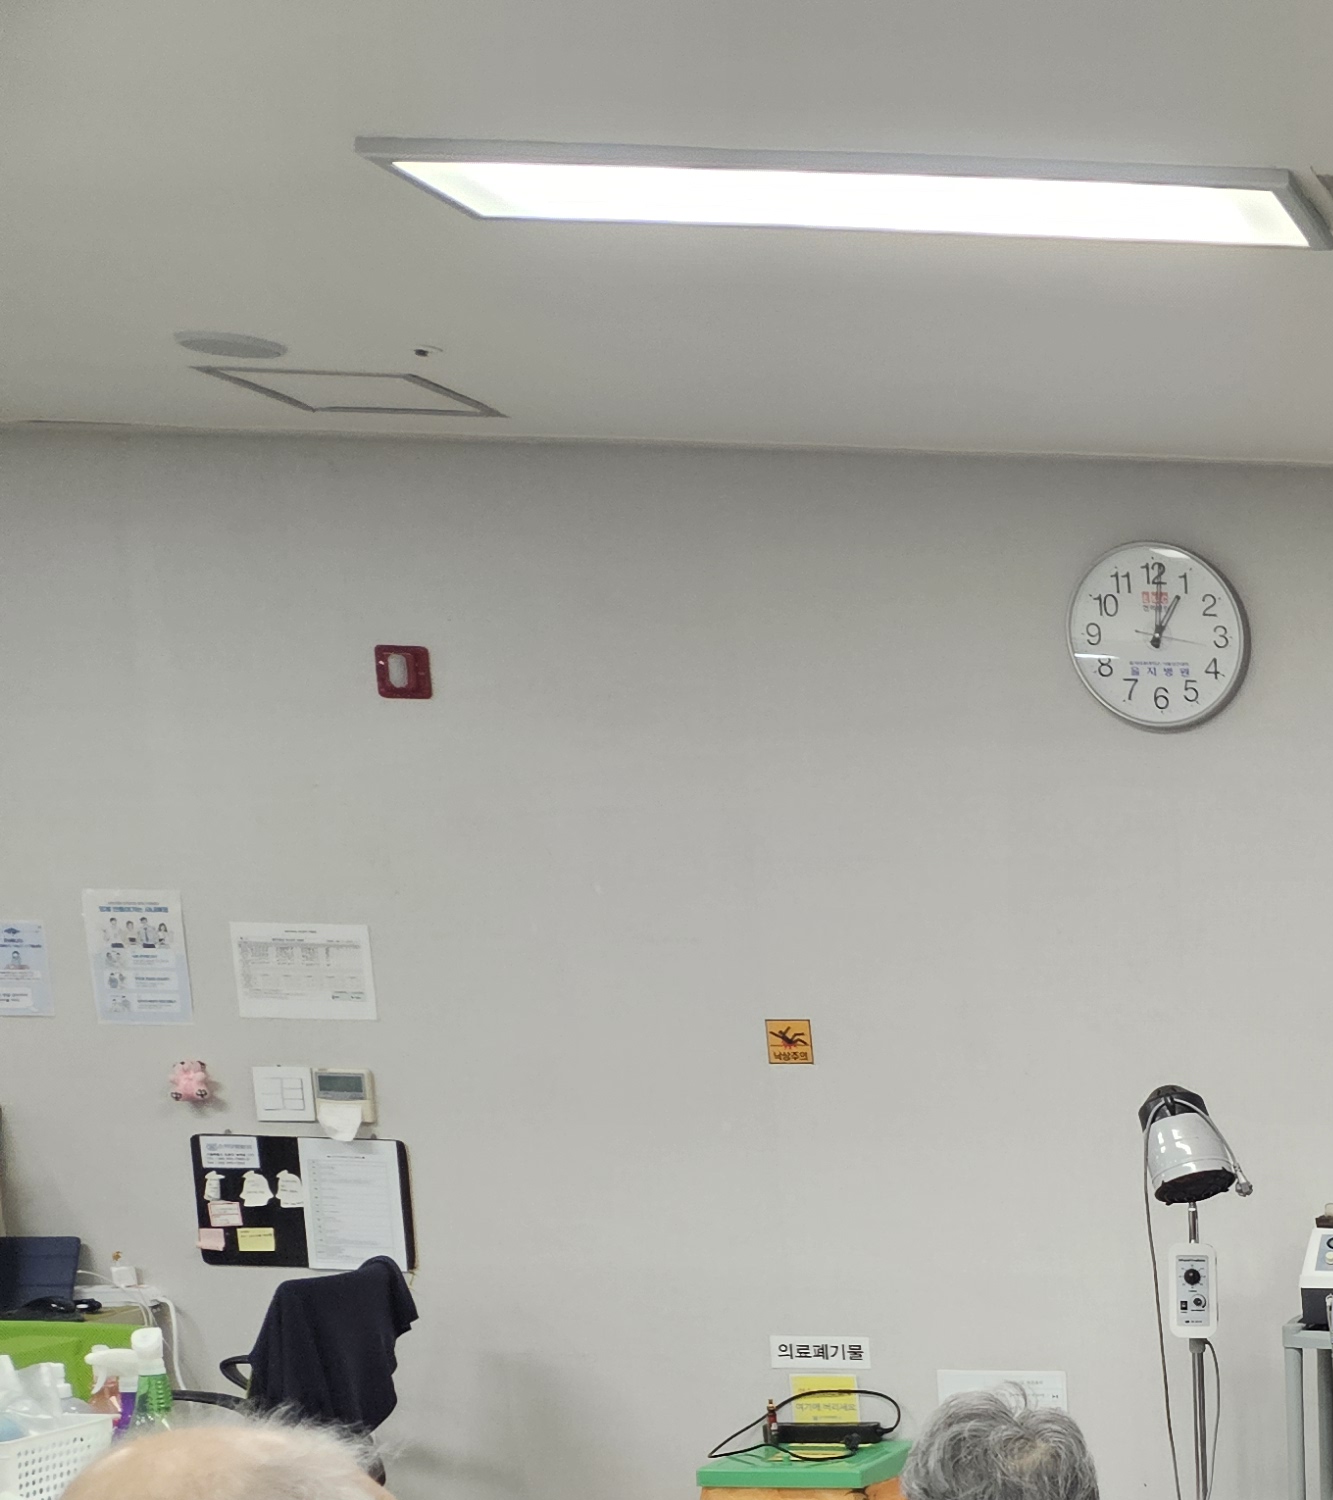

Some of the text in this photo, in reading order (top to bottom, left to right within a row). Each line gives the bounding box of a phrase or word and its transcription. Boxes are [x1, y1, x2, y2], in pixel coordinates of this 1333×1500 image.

[1110, 571, 1132, 594] 11
[1141, 562, 1167, 585] 12
[1179, 573, 1188, 594] 1
[1094, 594, 1118, 617] 10
[1202, 594, 1217, 617] 2
[1086, 622, 1102, 645] 9
[1214, 625, 1229, 649] 3
[1098, 655, 1113, 677] 8
[1205, 658, 1220, 680] 4
[1123, 678, 1138, 700] 7
[1154, 687, 1169, 709] 6
[1184, 680, 1199, 702] 5
[773, 1051, 808, 1061] 낙상주의
[778, 1343, 864, 1360] 의료폐기물
